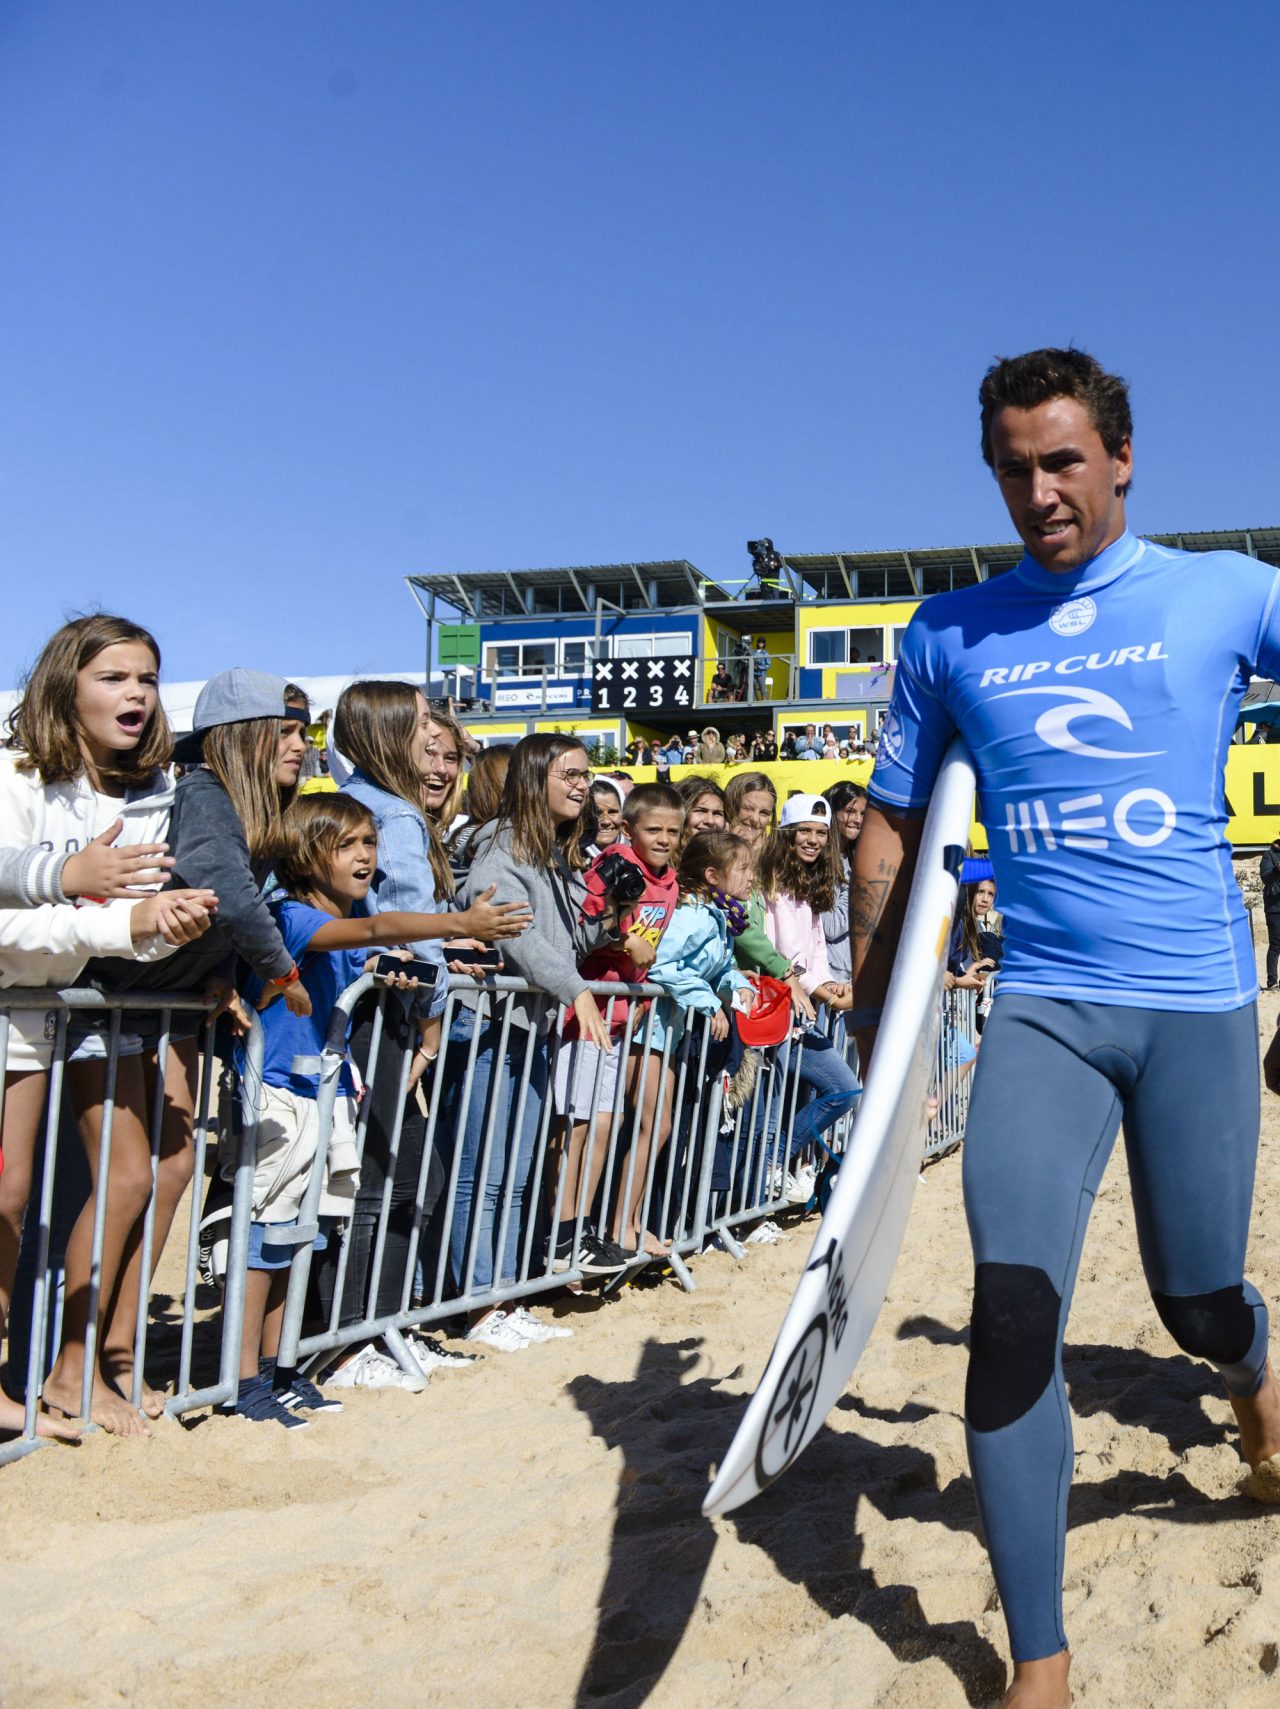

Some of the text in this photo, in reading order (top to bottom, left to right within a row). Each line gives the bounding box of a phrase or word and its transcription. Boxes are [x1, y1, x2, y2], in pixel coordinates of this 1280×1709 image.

[979, 641, 1169, 688] RIP CURL
[598, 685, 689, 708] 1 2 3 4
[1005, 788, 1177, 854] MEO
[637, 905, 667, 928] RIP
